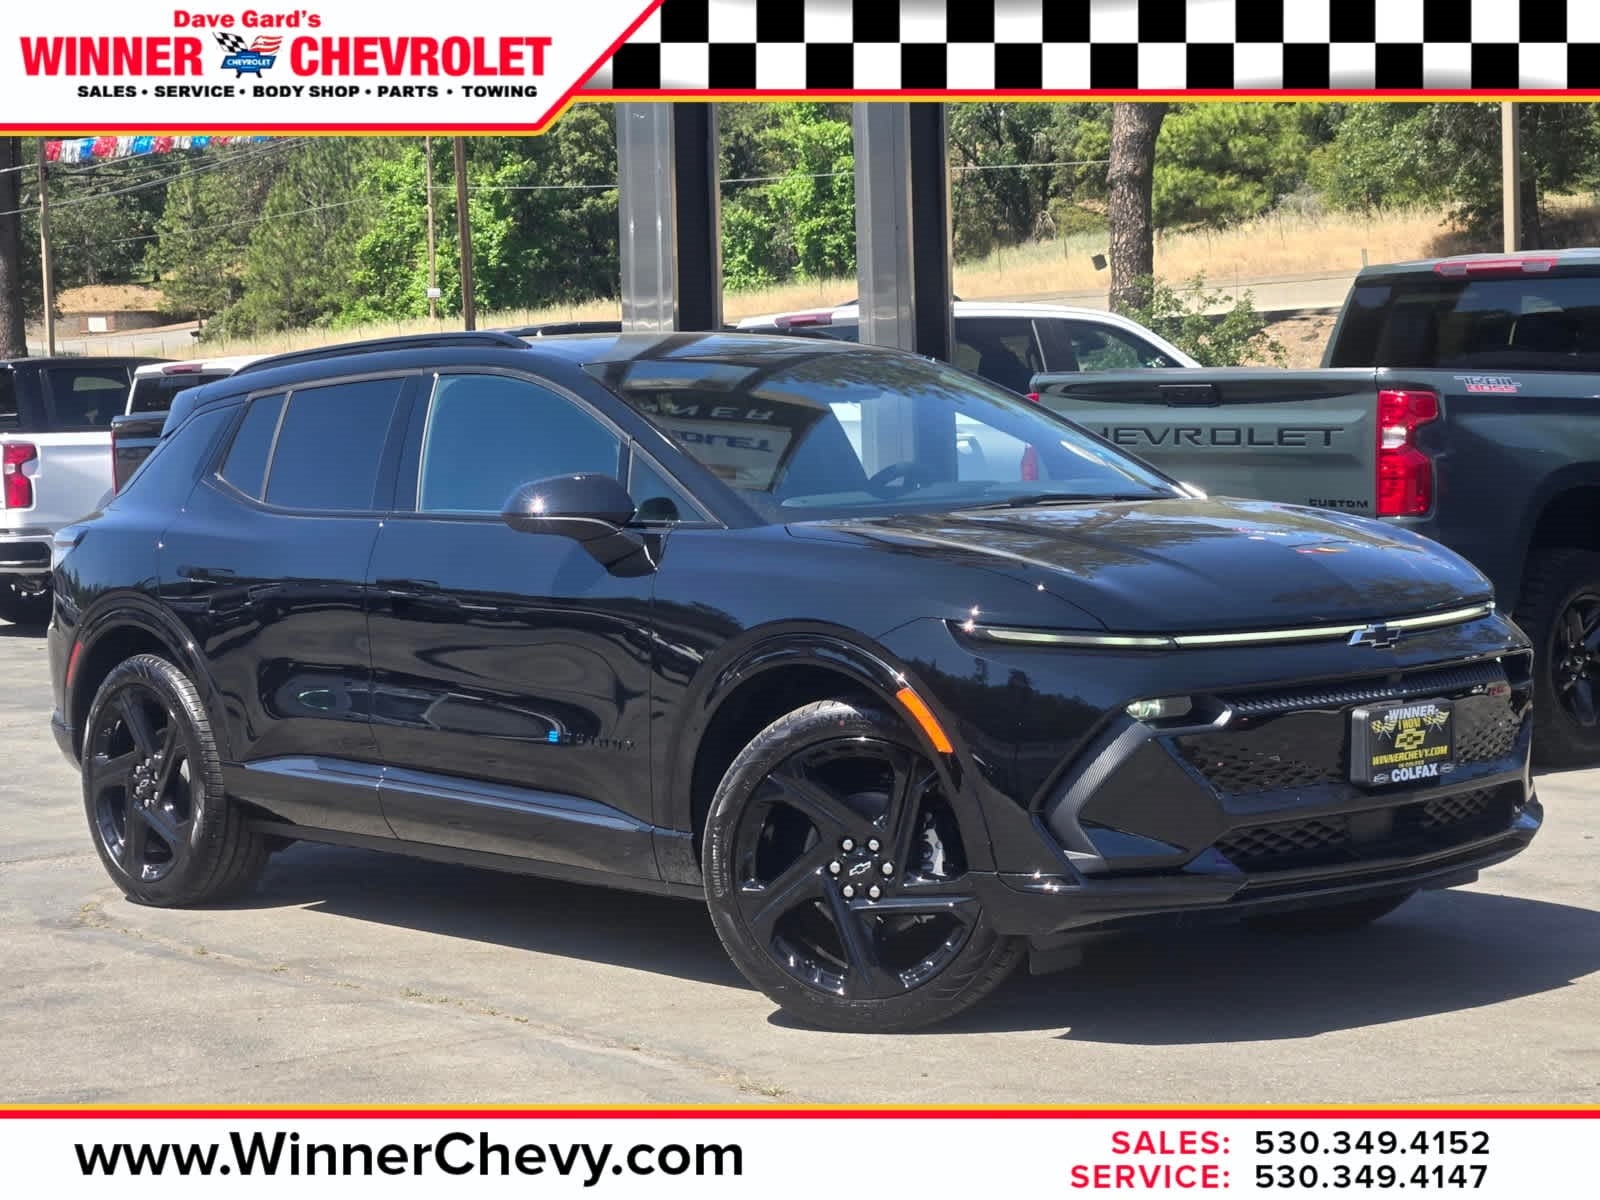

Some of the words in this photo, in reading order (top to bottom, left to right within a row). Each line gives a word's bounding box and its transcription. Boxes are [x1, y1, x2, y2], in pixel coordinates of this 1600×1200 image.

[1309, 498, 1369, 509] CUSTOM
[1388, 704, 1436, 721] WINNER
[1372, 745, 1448, 766] WINNERCHEVY.COM
[1391, 763, 1439, 783] COLFAX
